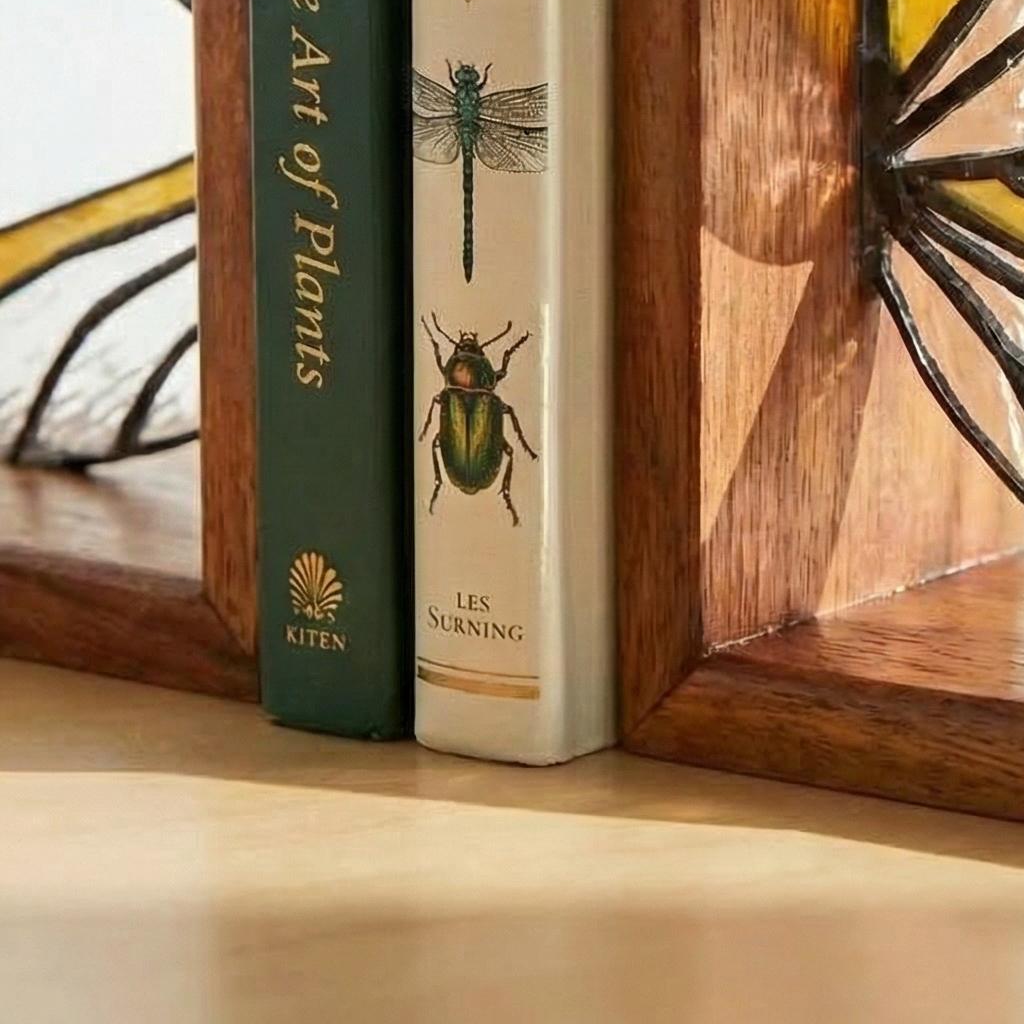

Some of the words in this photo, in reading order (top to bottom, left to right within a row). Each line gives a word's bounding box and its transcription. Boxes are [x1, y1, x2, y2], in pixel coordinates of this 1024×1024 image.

[291, 25, 330, 125] Art
[278, 142, 339, 210] of
[294, 211, 341, 388] Plants
[427, 605, 524, 642] SURNING
[456, 591, 491, 613] LES
[286, 622, 346, 651] KITEN
